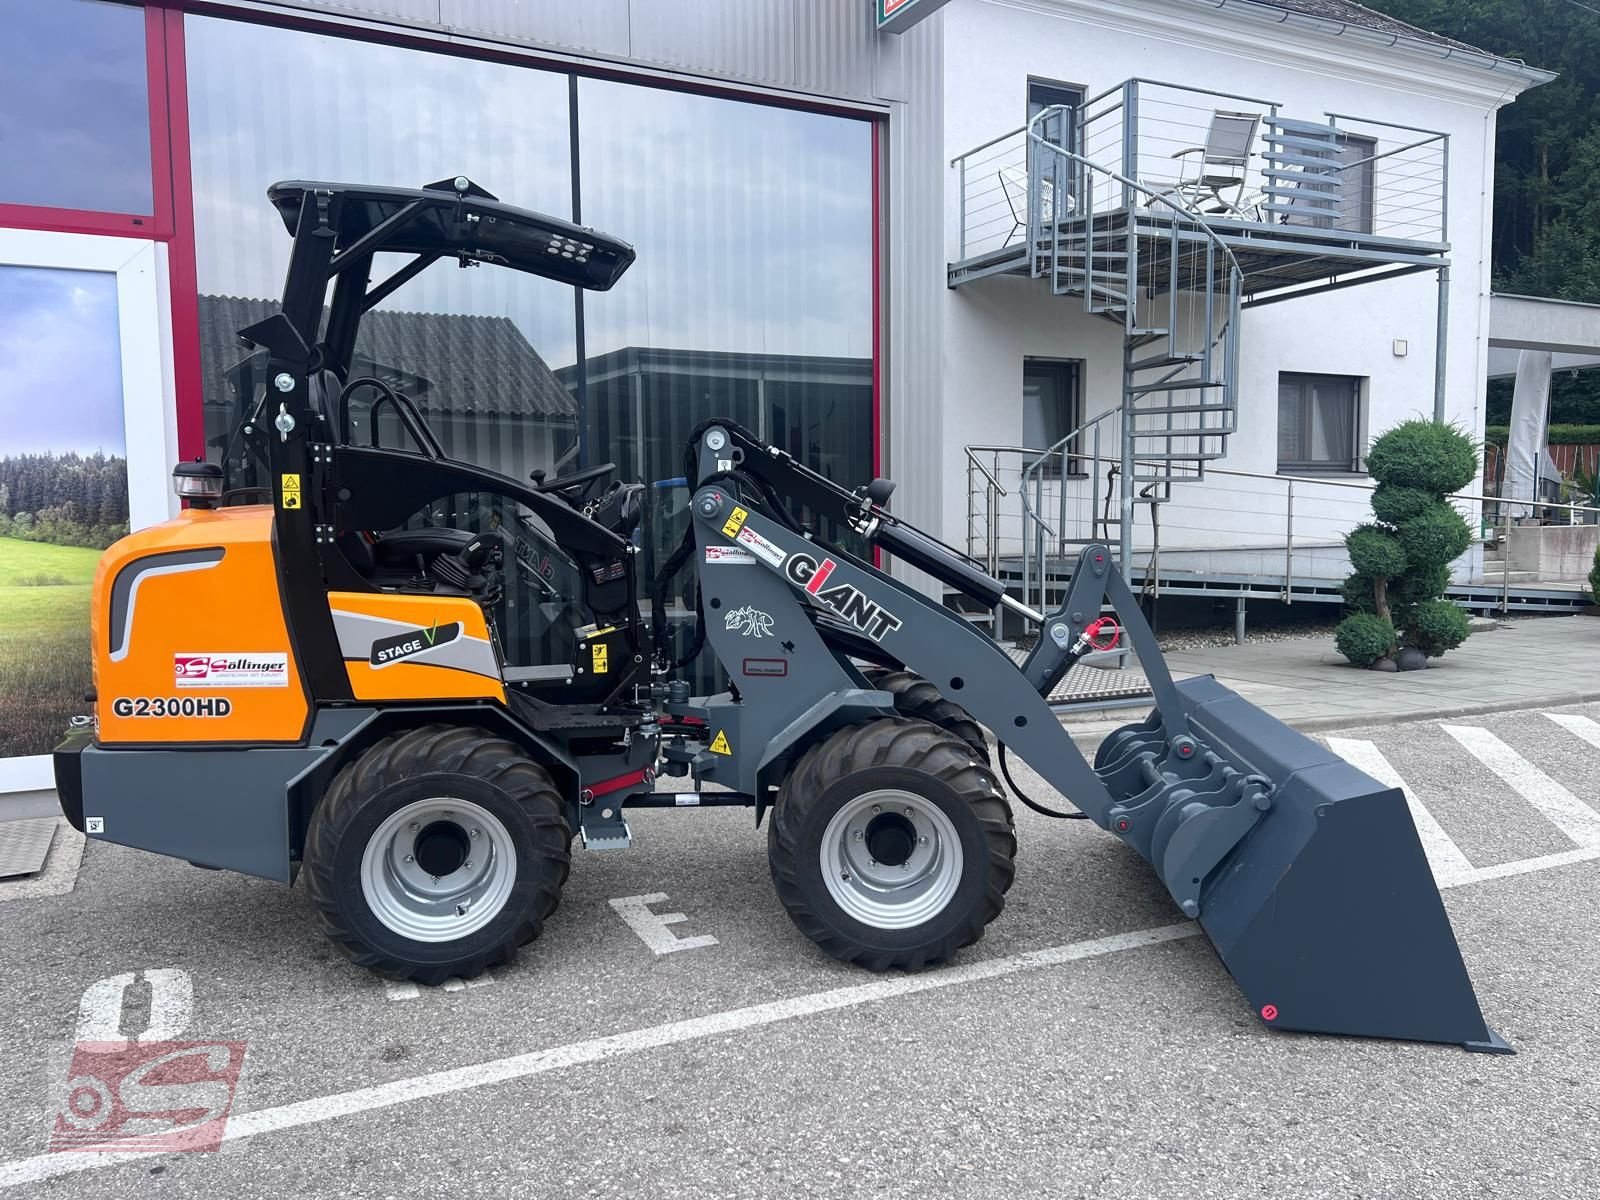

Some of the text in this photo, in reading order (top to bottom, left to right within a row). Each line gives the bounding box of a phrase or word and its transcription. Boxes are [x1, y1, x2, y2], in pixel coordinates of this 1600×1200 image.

[785, 552, 903, 642] GIANT
[377, 639, 422, 661] STAGE
[210, 659, 286, 673] Söllinger
[112, 696, 232, 718] G2300HD
